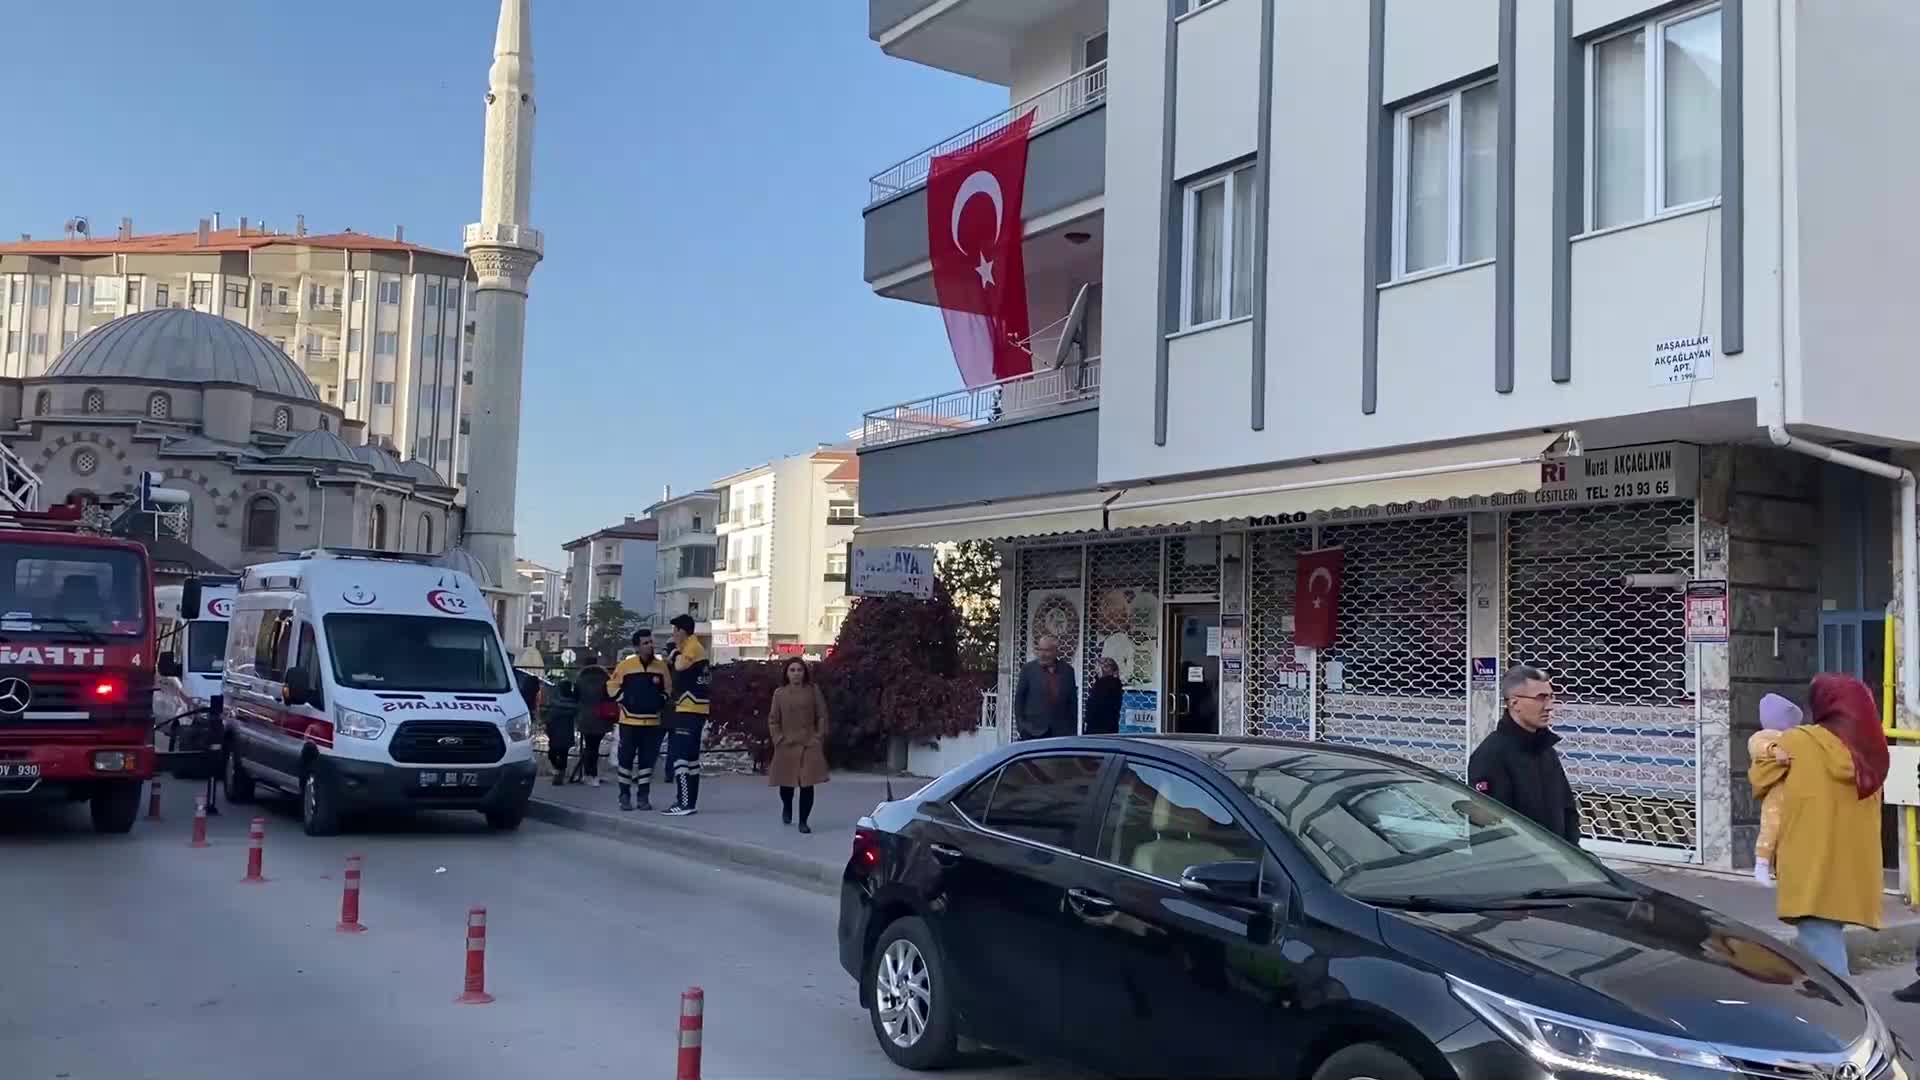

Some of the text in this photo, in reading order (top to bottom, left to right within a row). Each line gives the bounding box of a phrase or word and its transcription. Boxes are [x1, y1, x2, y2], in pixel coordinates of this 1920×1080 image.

[1656, 336, 1709, 351] MAŞAALLAH
[1673, 363, 1692, 373] APT.
[1584, 458, 1608, 477] Murat
[1586, 481, 1669, 500] TEL: 213 93 65
[437, 596, 468, 609] 112
[131, 653, 141, 666] 4
[18, 765, 38, 776] 930
